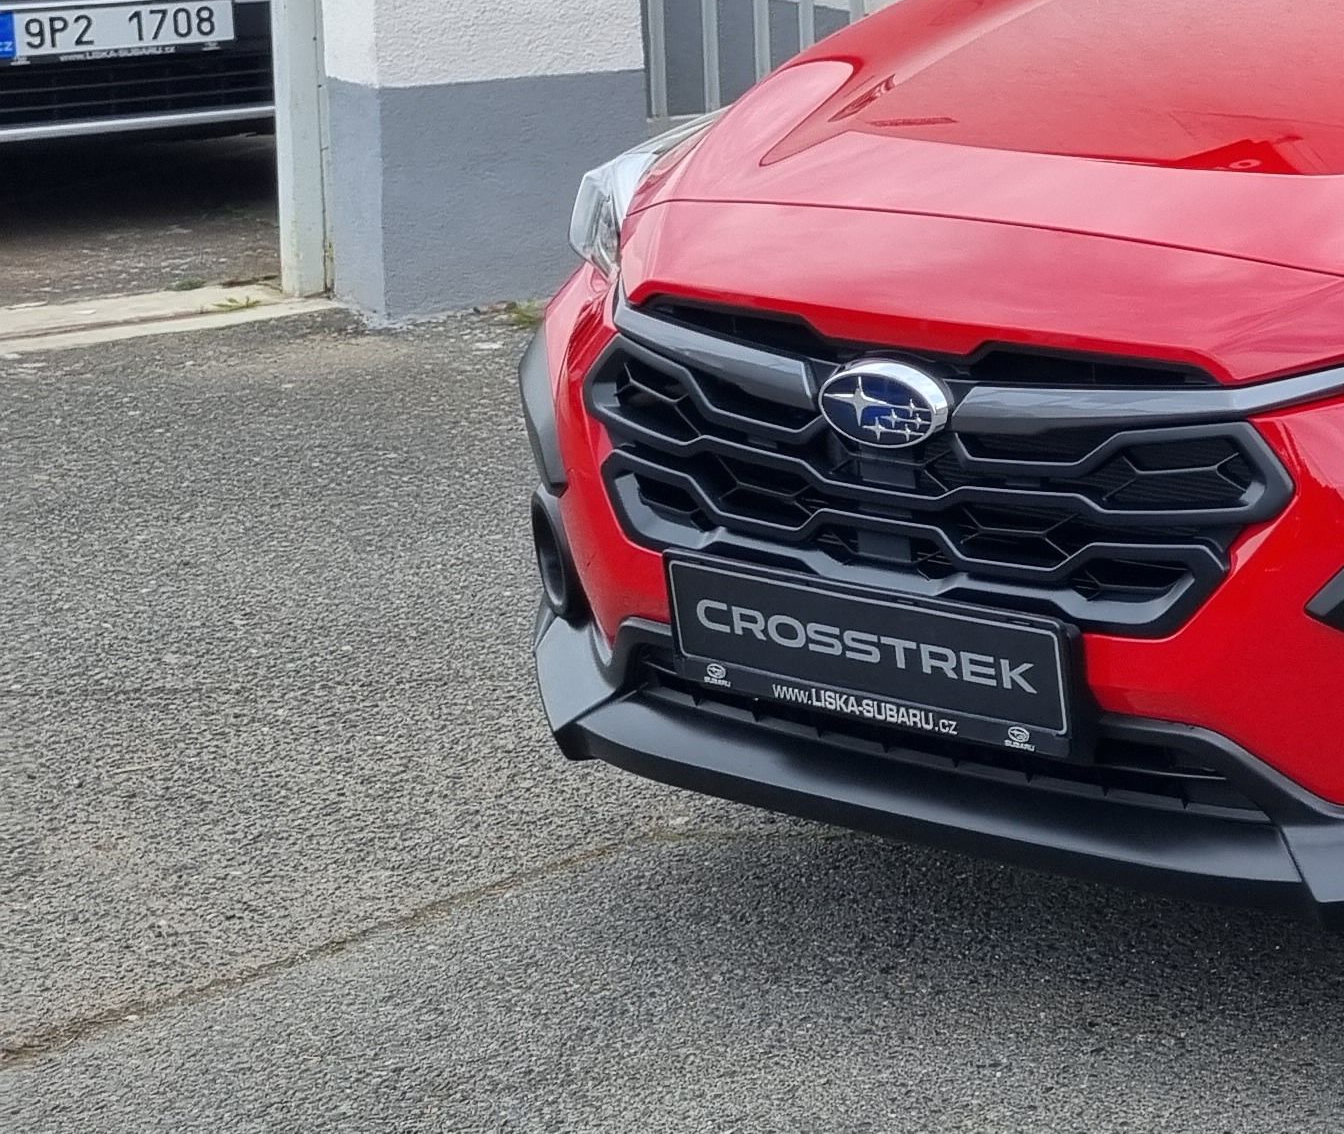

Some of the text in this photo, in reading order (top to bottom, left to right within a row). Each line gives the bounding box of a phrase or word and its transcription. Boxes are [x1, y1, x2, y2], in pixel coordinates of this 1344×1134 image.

[24, 6, 216, 49] 9P2 1708
[696, 599, 1038, 694] CROSSTREK
[704, 676, 731, 688] SUBARU
[772, 683, 958, 736] www.LISKA-SUBARU.cz
[1004, 739, 1035, 752] SUBARU
